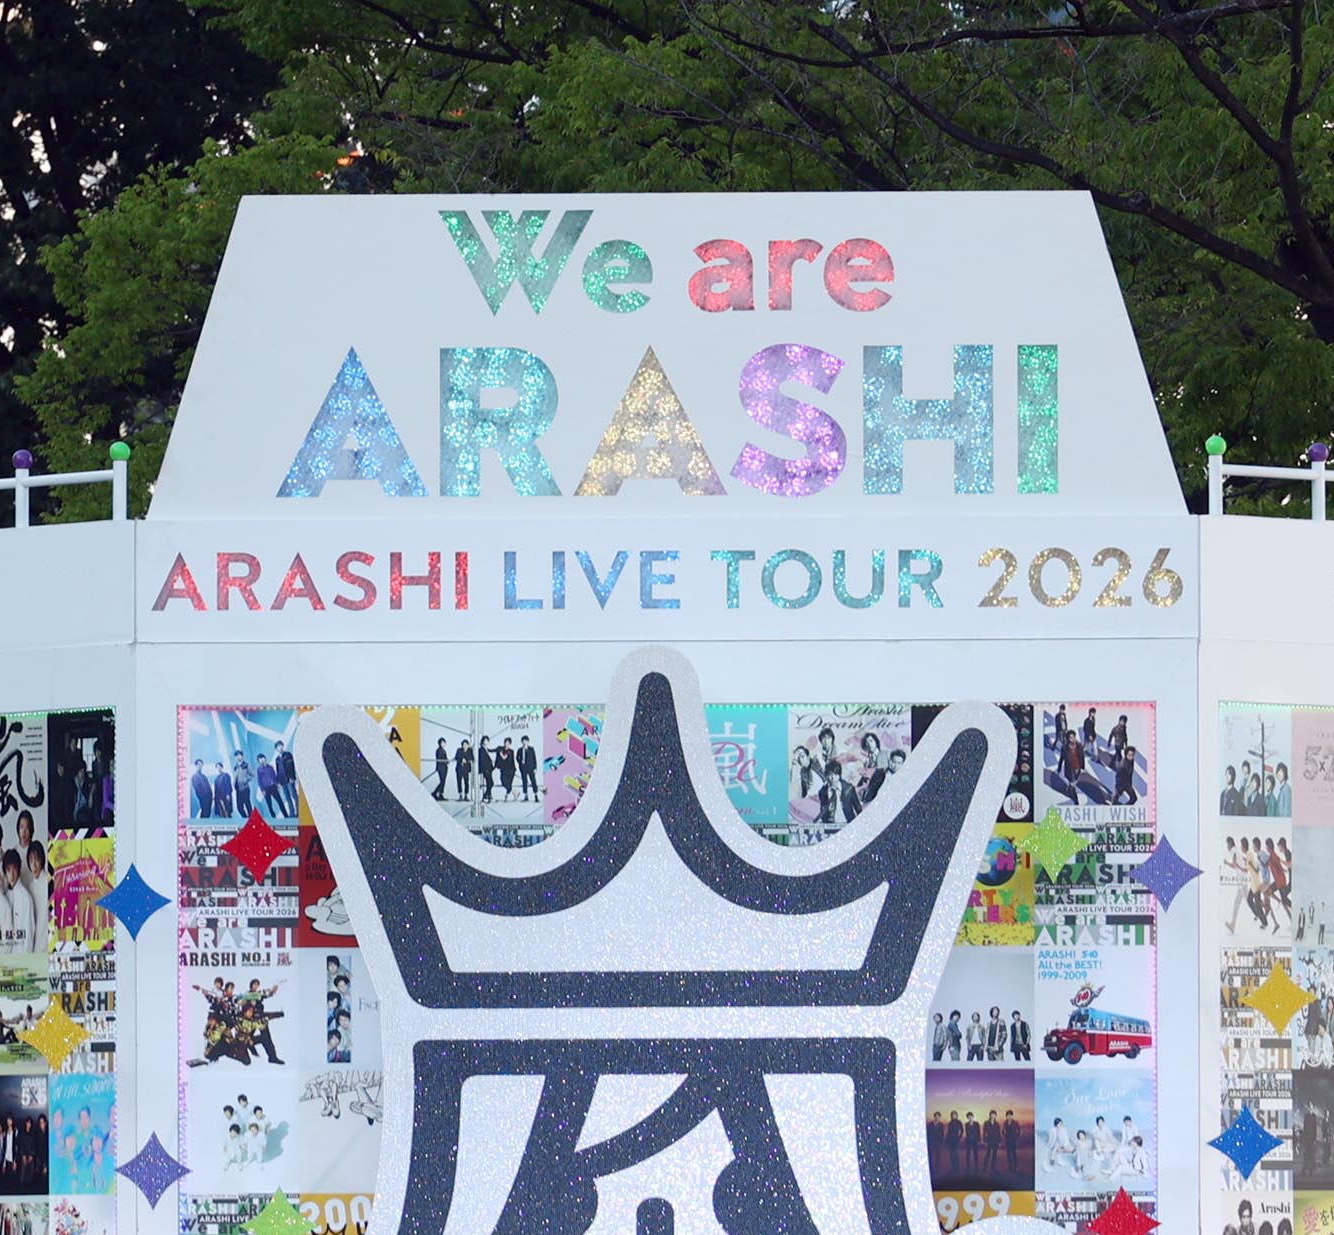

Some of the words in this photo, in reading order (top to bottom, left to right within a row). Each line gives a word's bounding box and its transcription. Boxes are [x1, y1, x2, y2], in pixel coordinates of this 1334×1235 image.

[438, 208, 653, 316] We
[687, 237, 895, 313] are
[275, 343, 1059, 499] ARASHI
[150, 550, 470, 611] ARASHI
[504, 549, 681, 611] LIVE
[710, 549, 944, 609] TOUR
[978, 546, 1185, 608] 2026
[1107, 808, 1147, 822] WISH
[1035, 864, 1137, 884] ARASH
[180, 929, 294, 948] ARASHI
[1035, 925, 1149, 946] ARASHI
[179, 952, 236, 967] ARASHI
[1038, 950, 1076, 959] ARASHI
[1054, 960, 1071, 970] the
[1075, 959, 1103, 970] BEST!
[1038, 970, 1088, 981] 1999-2009
[1258, 1201, 1291, 1214] Arashi
